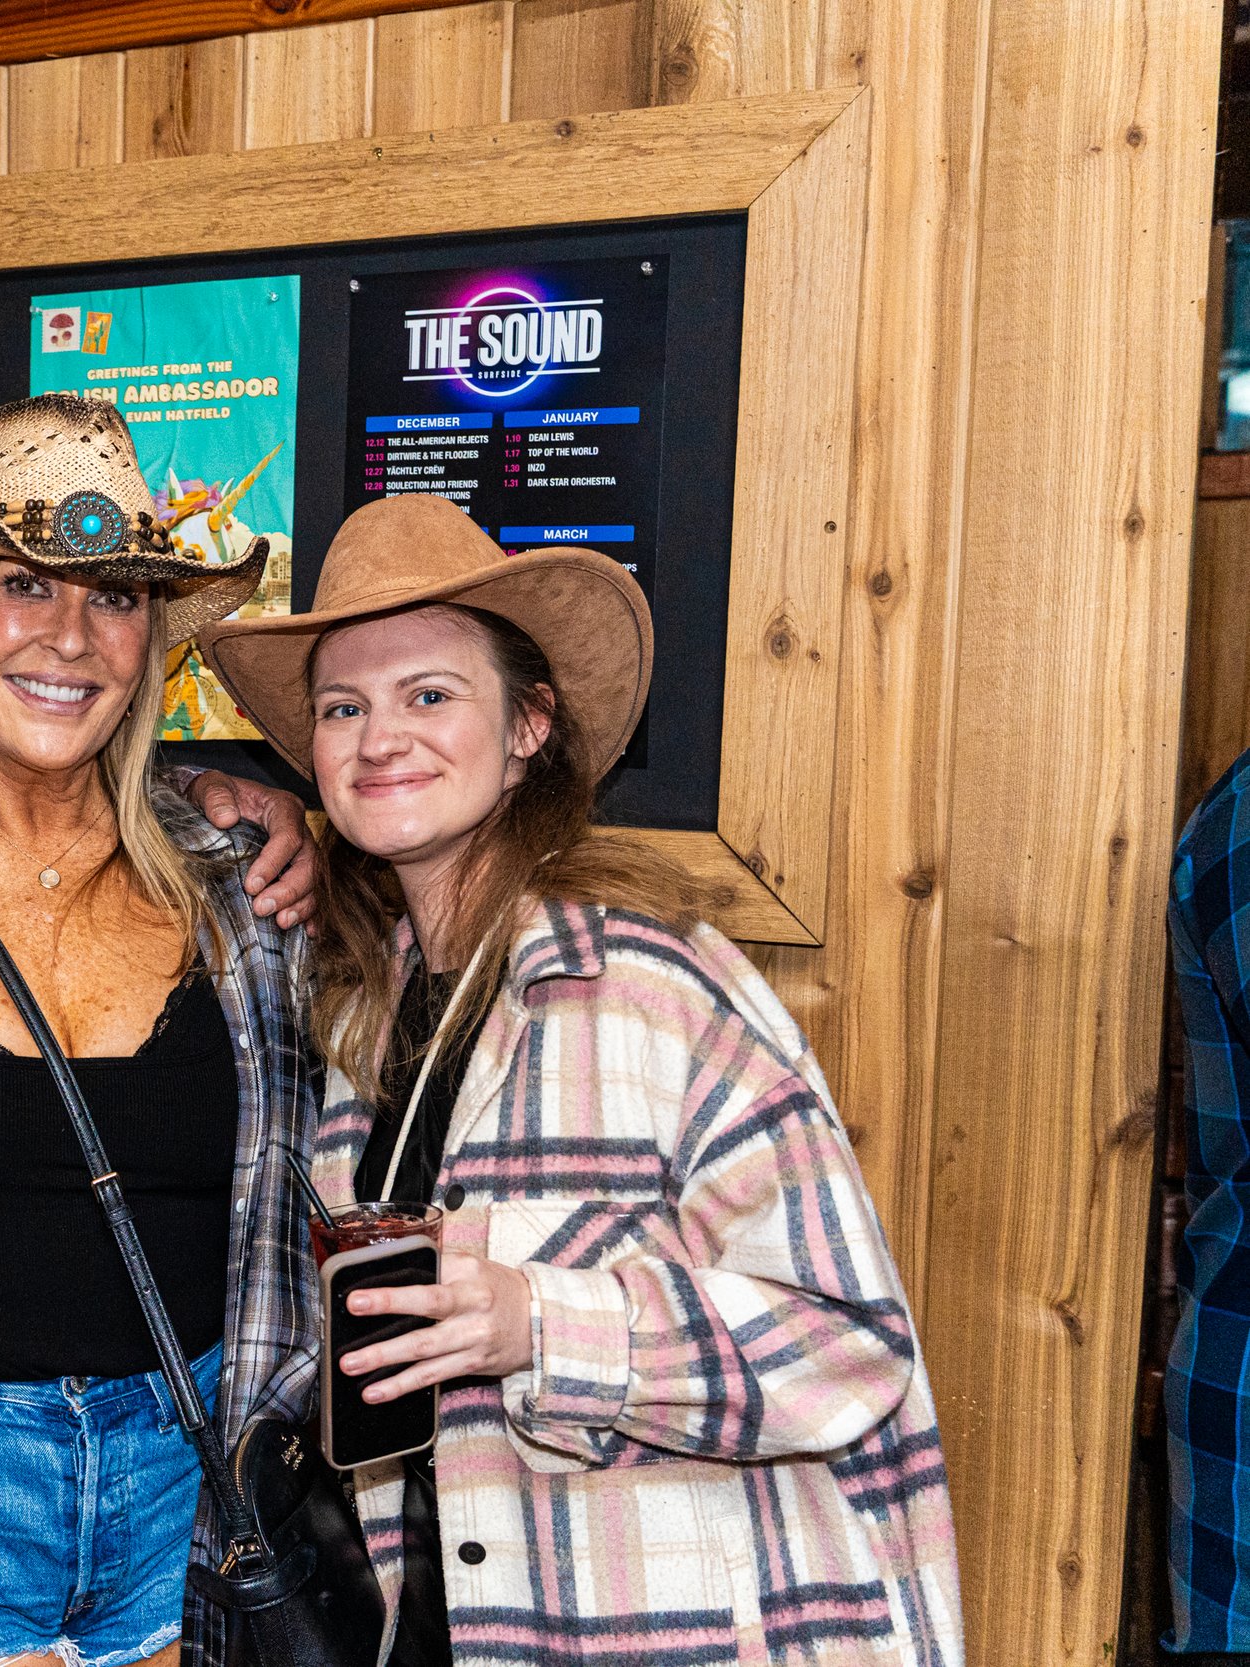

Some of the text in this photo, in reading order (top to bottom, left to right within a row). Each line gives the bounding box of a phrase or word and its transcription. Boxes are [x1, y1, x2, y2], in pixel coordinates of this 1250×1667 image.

[405, 309, 603, 370] THE SOUND
[87, 360, 233, 380] GREETINGS FROM THE
[478, 369, 522, 380] SURFSIDE
[124, 376, 279, 404] AMBASSADOR
[126, 407, 230, 423] EVAN HATFIELD
[542, 412, 599, 424] JANUARY
[397, 417, 460, 429] DECEMBER
[366, 435, 489, 447] 12.12 THE ALL-AMERICAN REJECTS
[505, 432, 575, 443] 1.10 DEAN LEWIS
[365, 450, 479, 461] 12.13 DIRTWIRE & THE FLOOZIES
[505, 446, 599, 458] 1.17 TOP OF THE WORLD
[365, 468, 383, 476] 12.27
[527, 463, 546, 472] INZO
[386, 481, 430, 490] SOULECTION
[431, 480, 446, 489] AND
[447, 480, 478, 489] FRIENDS
[504, 476, 616, 487] 1.31 DARK STAR ORCHESTRA
[543, 529, 588, 540] MARCH
